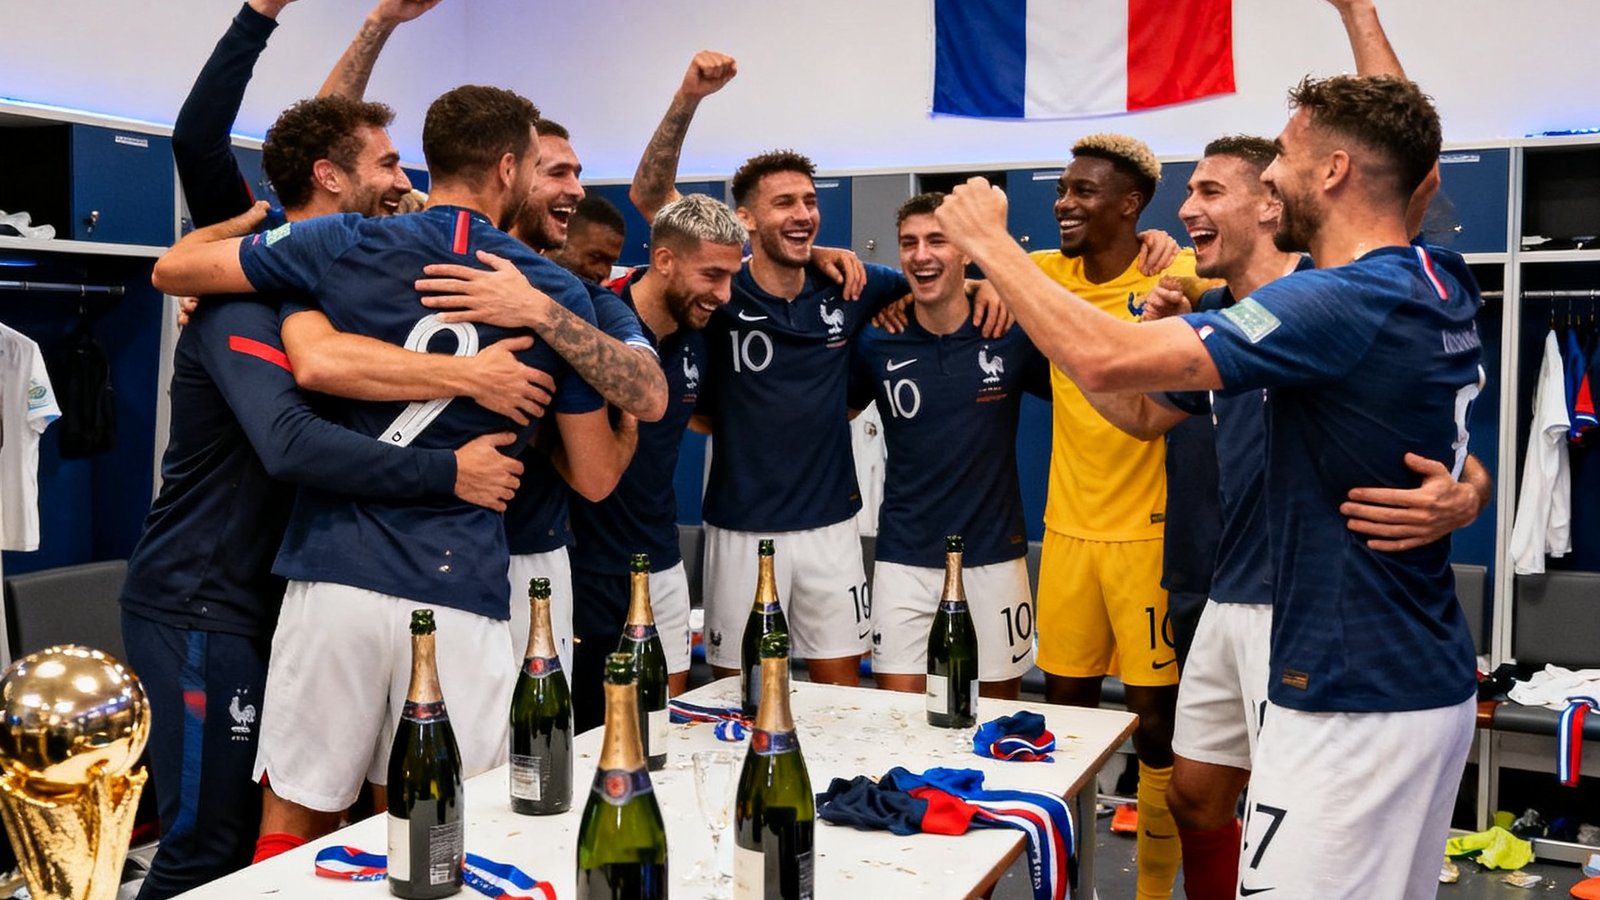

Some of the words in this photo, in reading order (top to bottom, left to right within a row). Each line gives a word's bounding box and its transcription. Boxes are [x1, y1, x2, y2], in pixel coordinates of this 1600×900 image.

[730, 330, 774, 373] 10
[377, 312, 479, 448] 9
[883, 378, 921, 418] 10
[1000, 602, 1032, 647] 10
